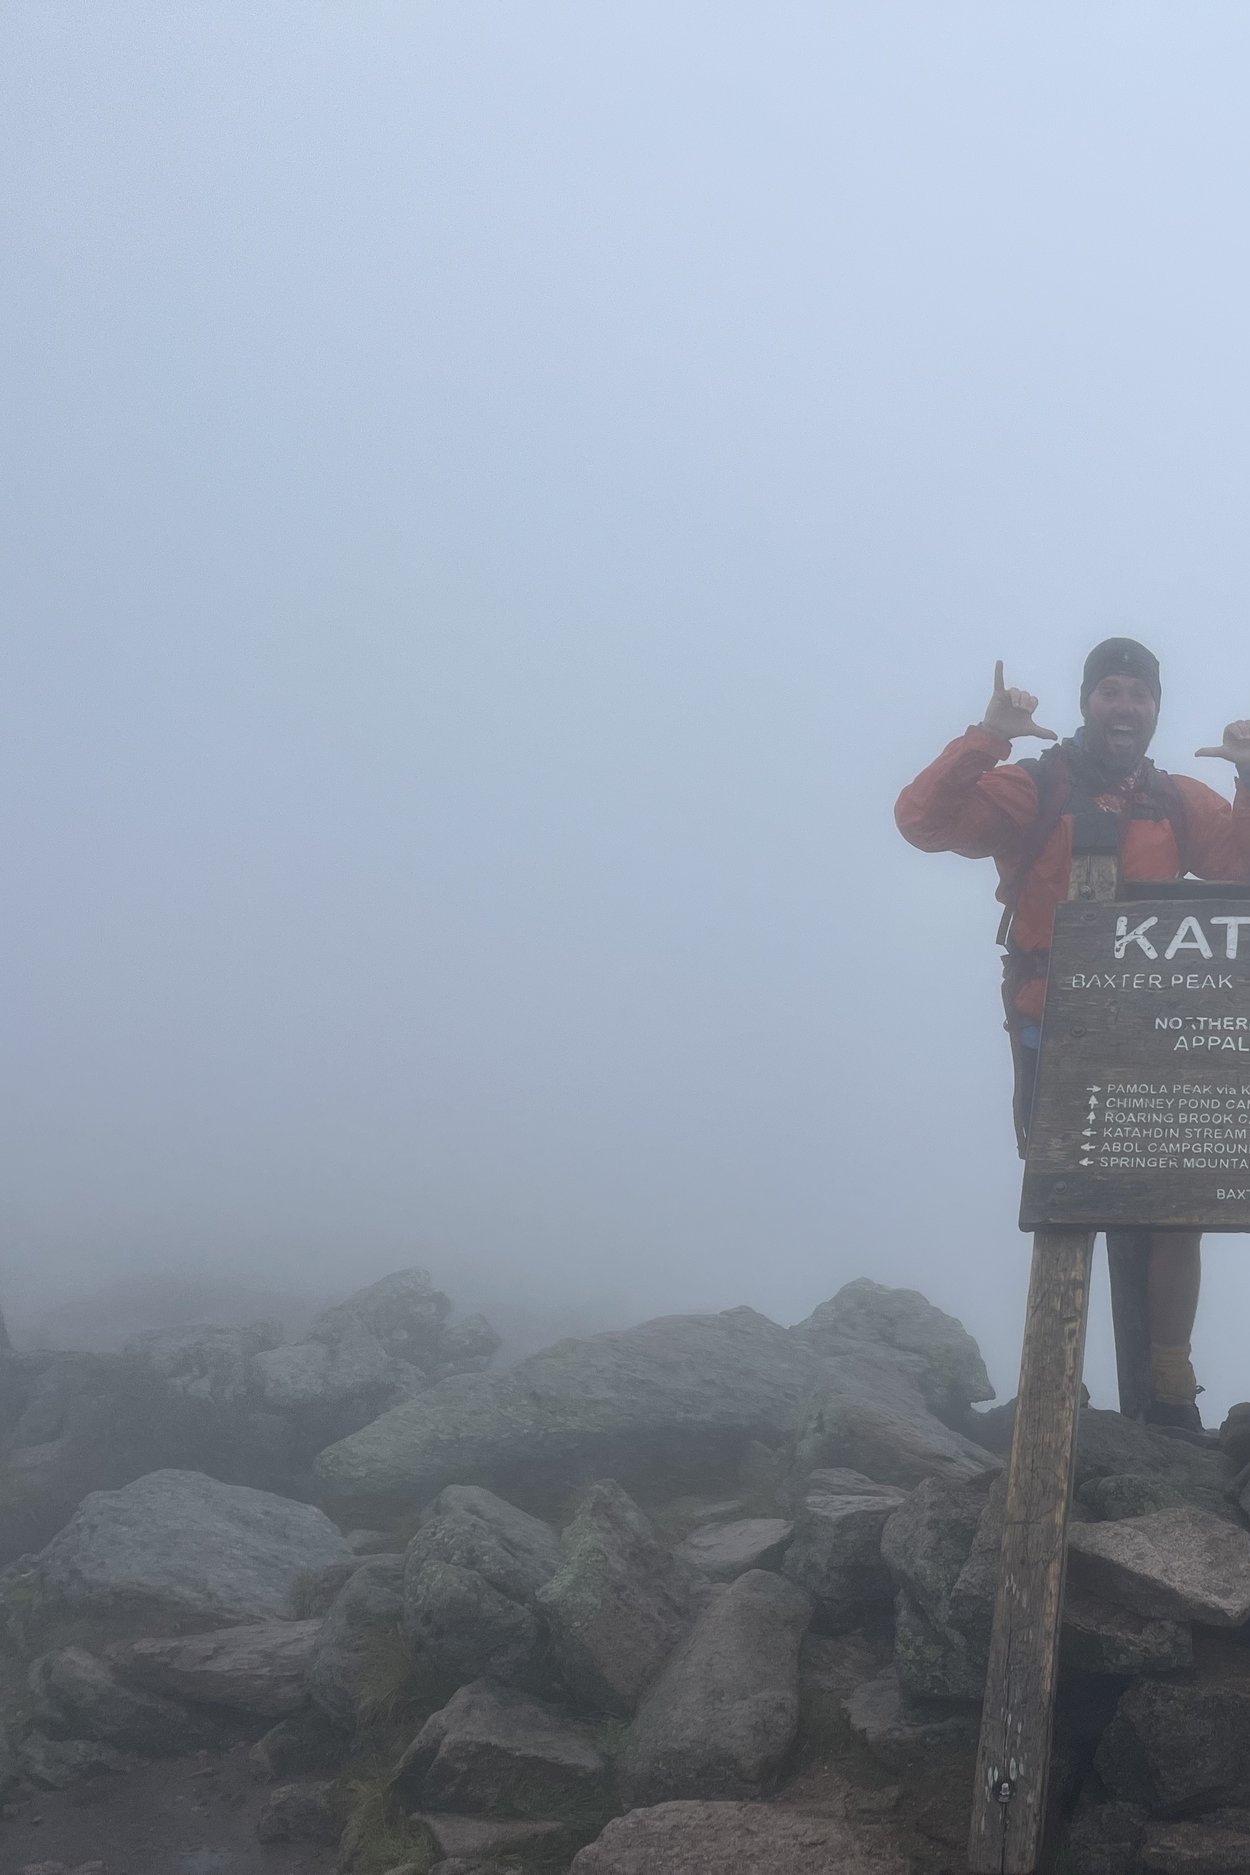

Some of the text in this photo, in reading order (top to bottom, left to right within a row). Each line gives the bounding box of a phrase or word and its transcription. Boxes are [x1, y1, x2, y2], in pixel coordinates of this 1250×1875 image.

[1071, 973, 1233, 989] BAXTER PEAK
[1107, 1083, 1168, 1094] PAMOLA
[1172, 1084, 1212, 1095] PEAK
[1216, 1085, 1237, 1096] via
[1105, 1097, 1175, 1109] CHIMNEY
[1178, 1098, 1221, 1110] POND
[1104, 1112, 1174, 1124] ROARING
[1178, 1113, 1234, 1124] BROOK
[1103, 1127, 1180, 1139] KATAHDIN
[1184, 1128, 1247, 1140] STREAM
[1100, 1142, 1143, 1153] ABOL
[1099, 1157, 1178, 1168] SPRINGER
